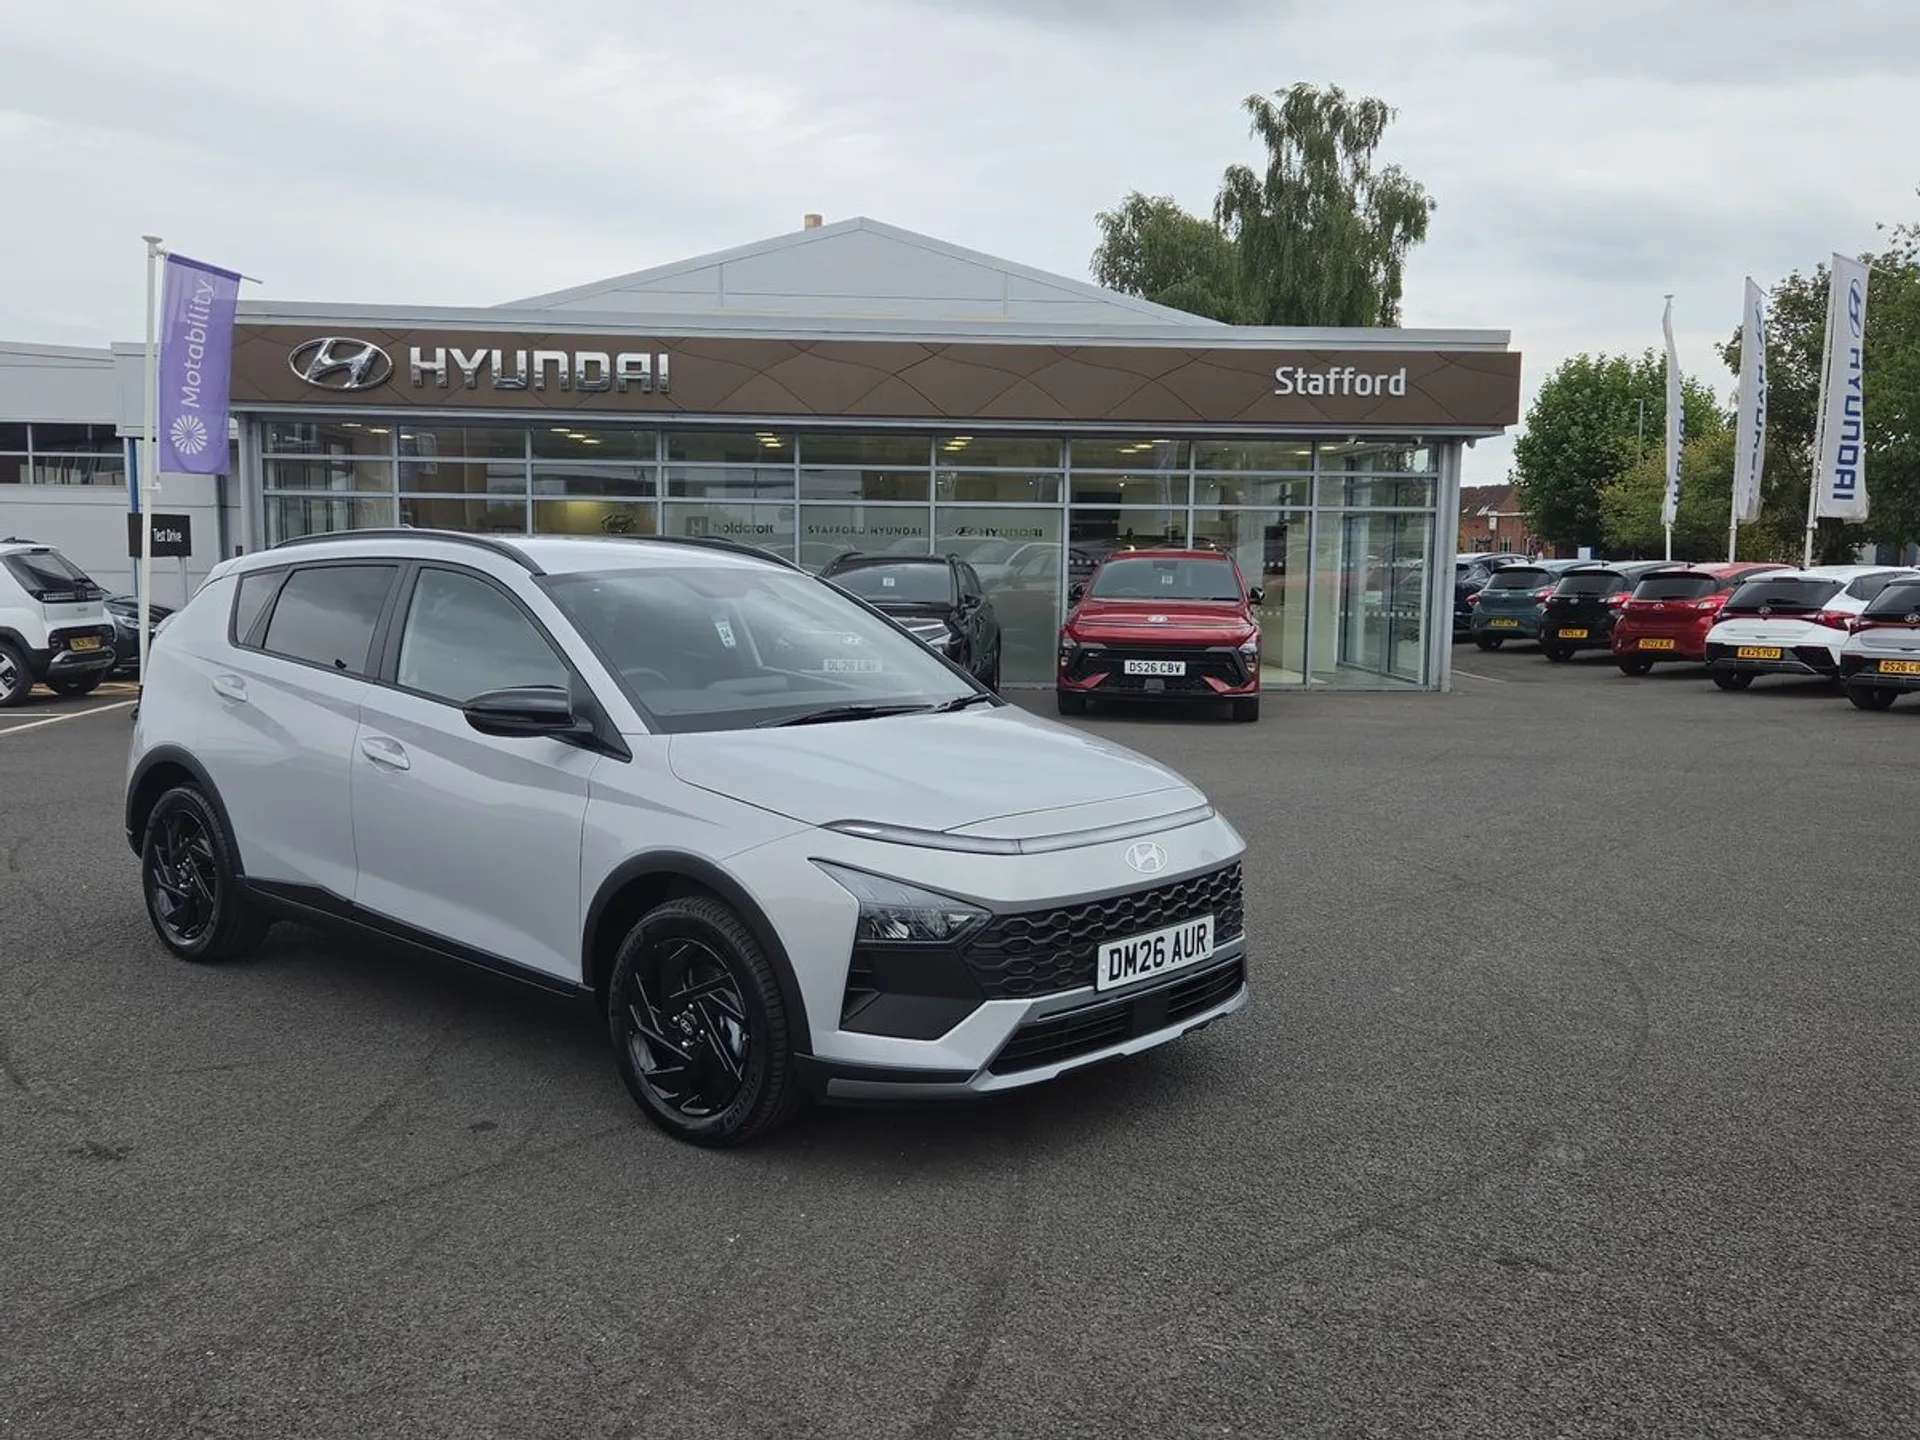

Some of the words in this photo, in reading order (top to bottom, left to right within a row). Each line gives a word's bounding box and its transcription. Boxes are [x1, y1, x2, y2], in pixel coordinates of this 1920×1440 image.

[182, 280, 214, 408] Motability
[409, 347, 670, 393] HYUNDAI
[1274, 366, 1407, 396] Stafford
[1832, 347, 1862, 500] HYUNDAI
[152, 527, 166, 542] Test
[166, 528, 182, 543] Drive
[808, 524, 865, 535] STAFFORD
[870, 525, 922, 536] HYUNDAI
[1129, 662, 1157, 672] DS26
[1109, 936, 1165, 981] DM26
[1171, 923, 1207, 962] AUR
